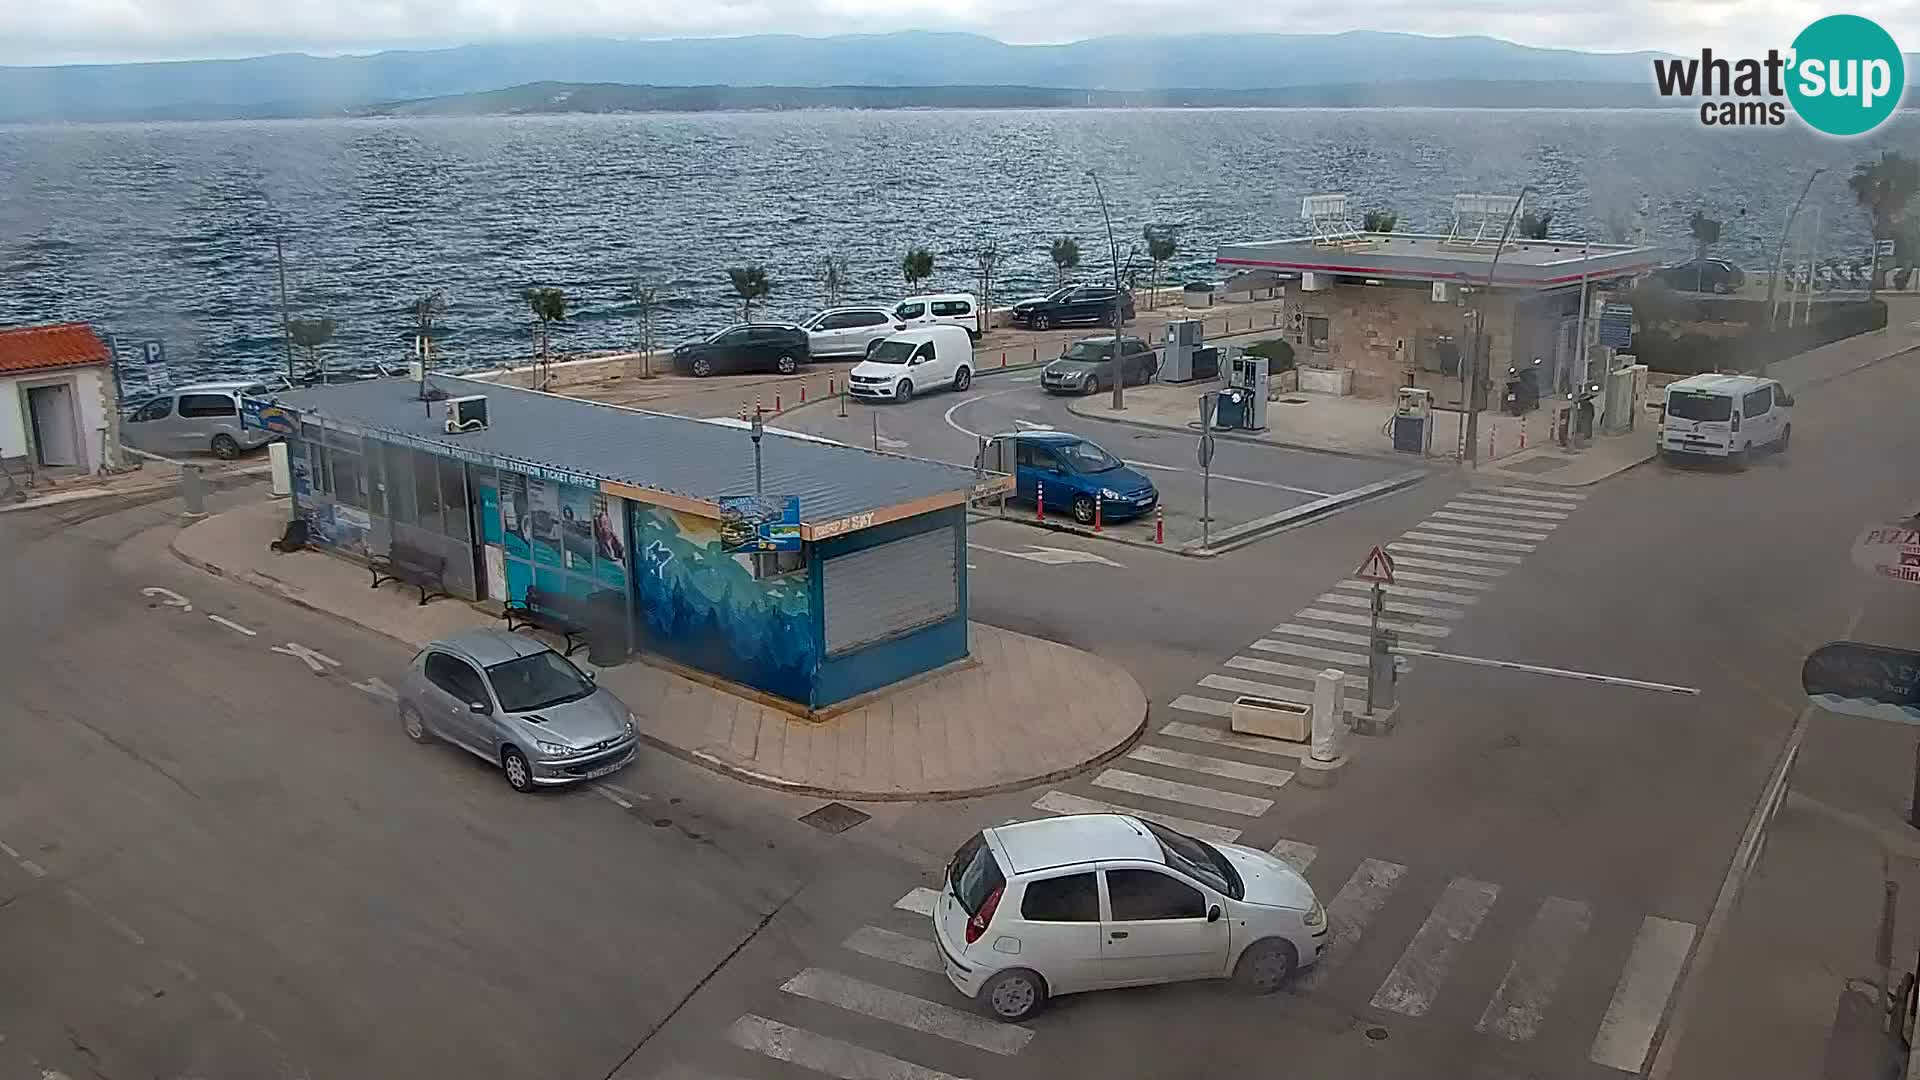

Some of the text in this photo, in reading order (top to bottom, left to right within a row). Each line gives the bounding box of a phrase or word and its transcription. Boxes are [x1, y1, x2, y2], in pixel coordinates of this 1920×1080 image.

[148, 343, 160, 361] P
[509, 461, 541, 478] STATION
[542, 468, 568, 483] TICKET
[569, 475, 597, 489] OFFICE
[1864, 528, 1920, 545] PIZZ
